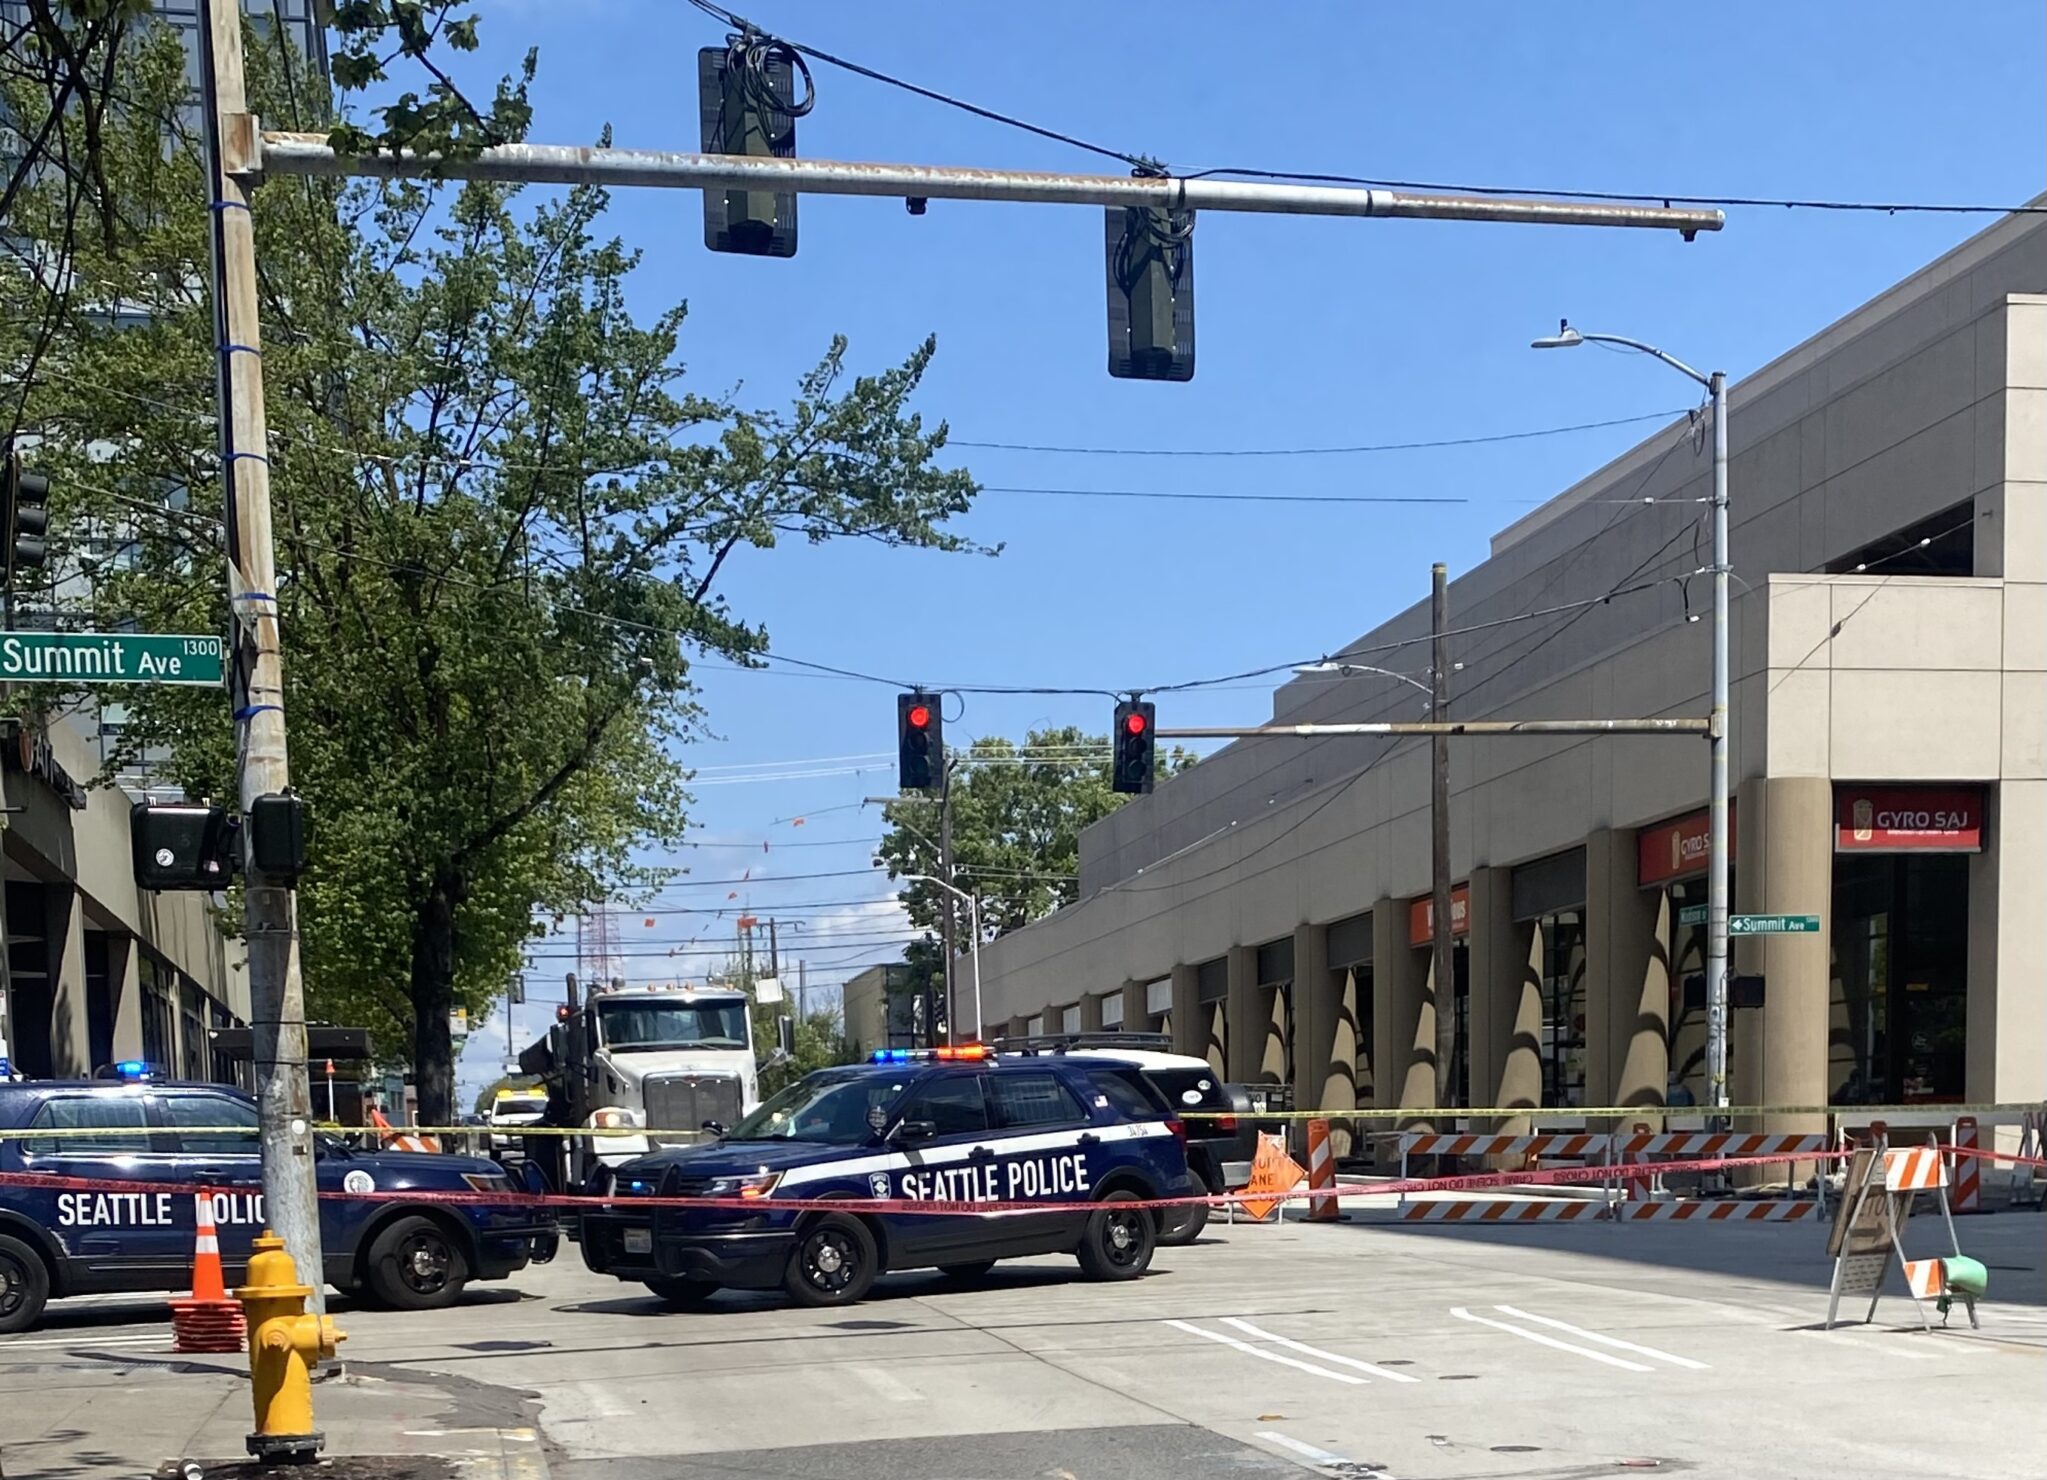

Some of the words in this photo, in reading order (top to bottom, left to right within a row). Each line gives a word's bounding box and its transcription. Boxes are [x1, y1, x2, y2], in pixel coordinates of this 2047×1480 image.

[183, 639, 218, 656] 1300
[2, 638, 126, 675] Summit
[137, 651, 182, 675] Ave
[1876, 811, 1930, 828] GYRO
[1934, 811, 1968, 828] SAJ
[1743, 917, 1786, 932] Summit
[1788, 921, 1805, 931] Ave
[902, 1165, 998, 1201] SEATTLE
[1008, 1154, 1090, 1199] POLICE
[1250, 1173, 1275, 1186] ANE
[1592, 1168, 1613, 1179] NOT
[1428, 1180, 1447, 1190] NOT
[1449, 1178, 1464, 1189] DO
[57, 1193, 173, 1226] SEATTLE
[195, 1193, 265, 1225] OLIC
